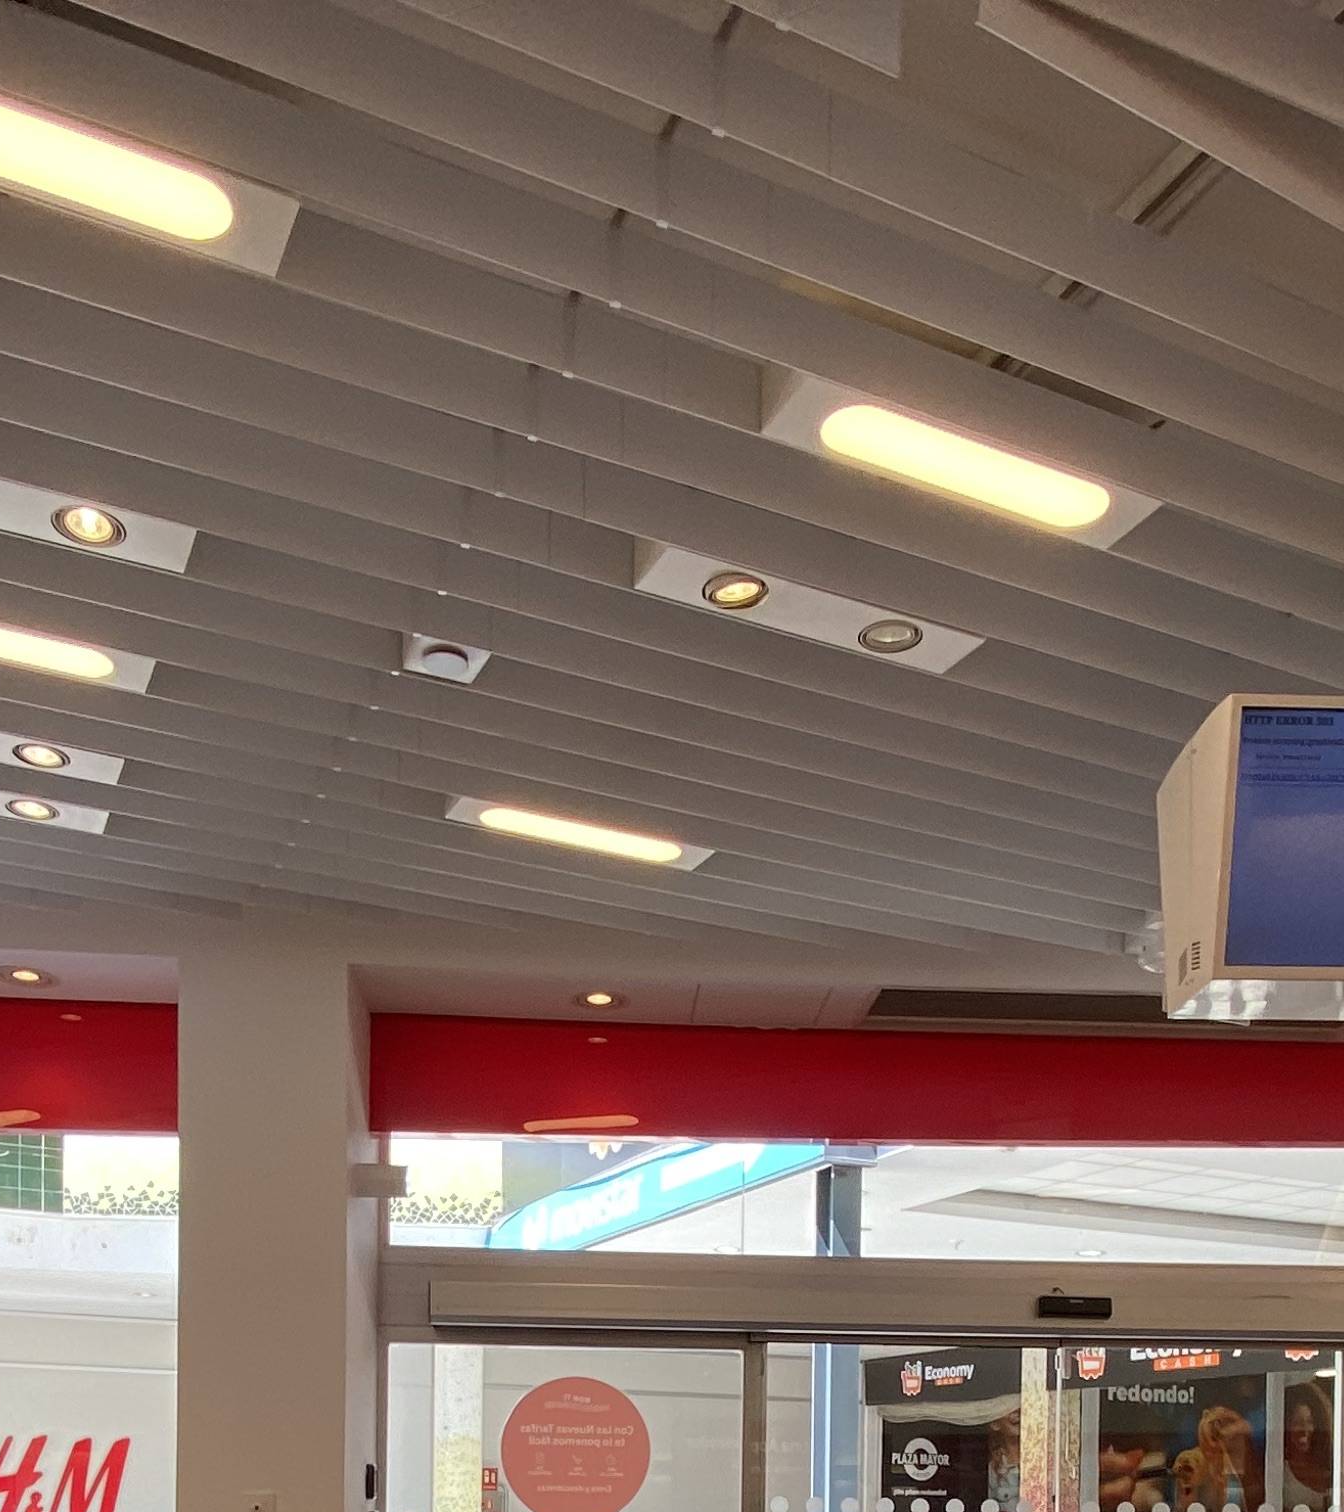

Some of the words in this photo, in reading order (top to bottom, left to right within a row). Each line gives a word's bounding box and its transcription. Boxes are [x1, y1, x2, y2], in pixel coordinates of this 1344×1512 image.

[1275, 716, 1314, 726] ERROR
[1159, 1354, 1213, 1369] CASH
[924, 1364, 975, 1380] Economy
[1107, 1384, 1196, 1404] redondo!
[891, 1452, 918, 1465] PLAZA
[920, 1453, 950, 1466] MAYOR
